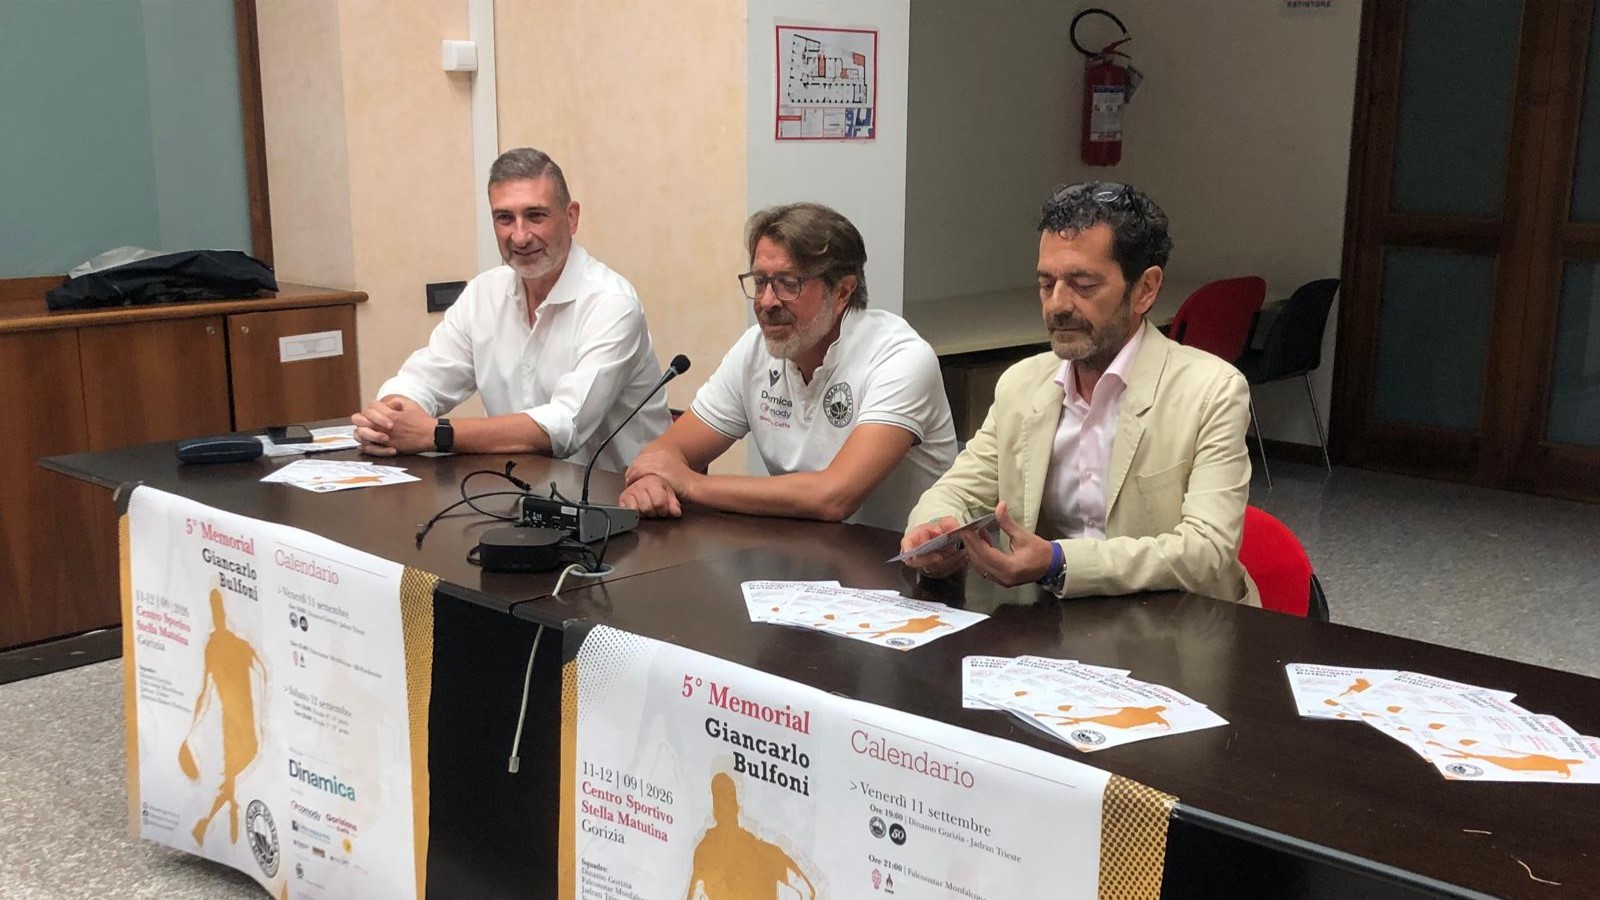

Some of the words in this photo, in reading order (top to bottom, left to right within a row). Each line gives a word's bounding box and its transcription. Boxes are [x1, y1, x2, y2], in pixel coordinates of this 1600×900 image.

[201, 521, 255, 556] Memorial
[202, 547, 257, 581] Giancarlo
[274, 549, 339, 585] Calendario
[219, 573, 258, 602] Bulfoni
[681, 673, 703, 698] 5°
[708, 681, 811, 735] Memorial
[704, 717, 811, 769] Giancarlo
[850, 729, 975, 789] Calendario
[288, 758, 356, 801] Dinamica
[582, 761, 613, 783] 11-12
[623, 774, 638, 790] 09
[646, 783, 674, 805] 2026
[733, 751, 811, 797] Bulfoni
[582, 780, 622, 806] Centro
[626, 792, 674, 825] Sportivo
[582, 800, 614, 822] Stella
[617, 810, 669, 843] Matutina
[860, 781, 907, 808] Venerdì
[912, 798, 924, 815] 11
[928, 804, 992, 837] settembre
[581, 818, 625, 845] Gorizia
[869, 803, 883, 814] Ore
[885, 808, 904, 822] 19:00
[908, 817, 936, 833] Dinamo
[938, 827, 965, 843] Gorizia
[969, 837, 994, 853] Jadran
[997, 846, 1022, 864] Trieste
[868, 854, 882, 866] Ore
[883, 860, 903, 872] 21:00
